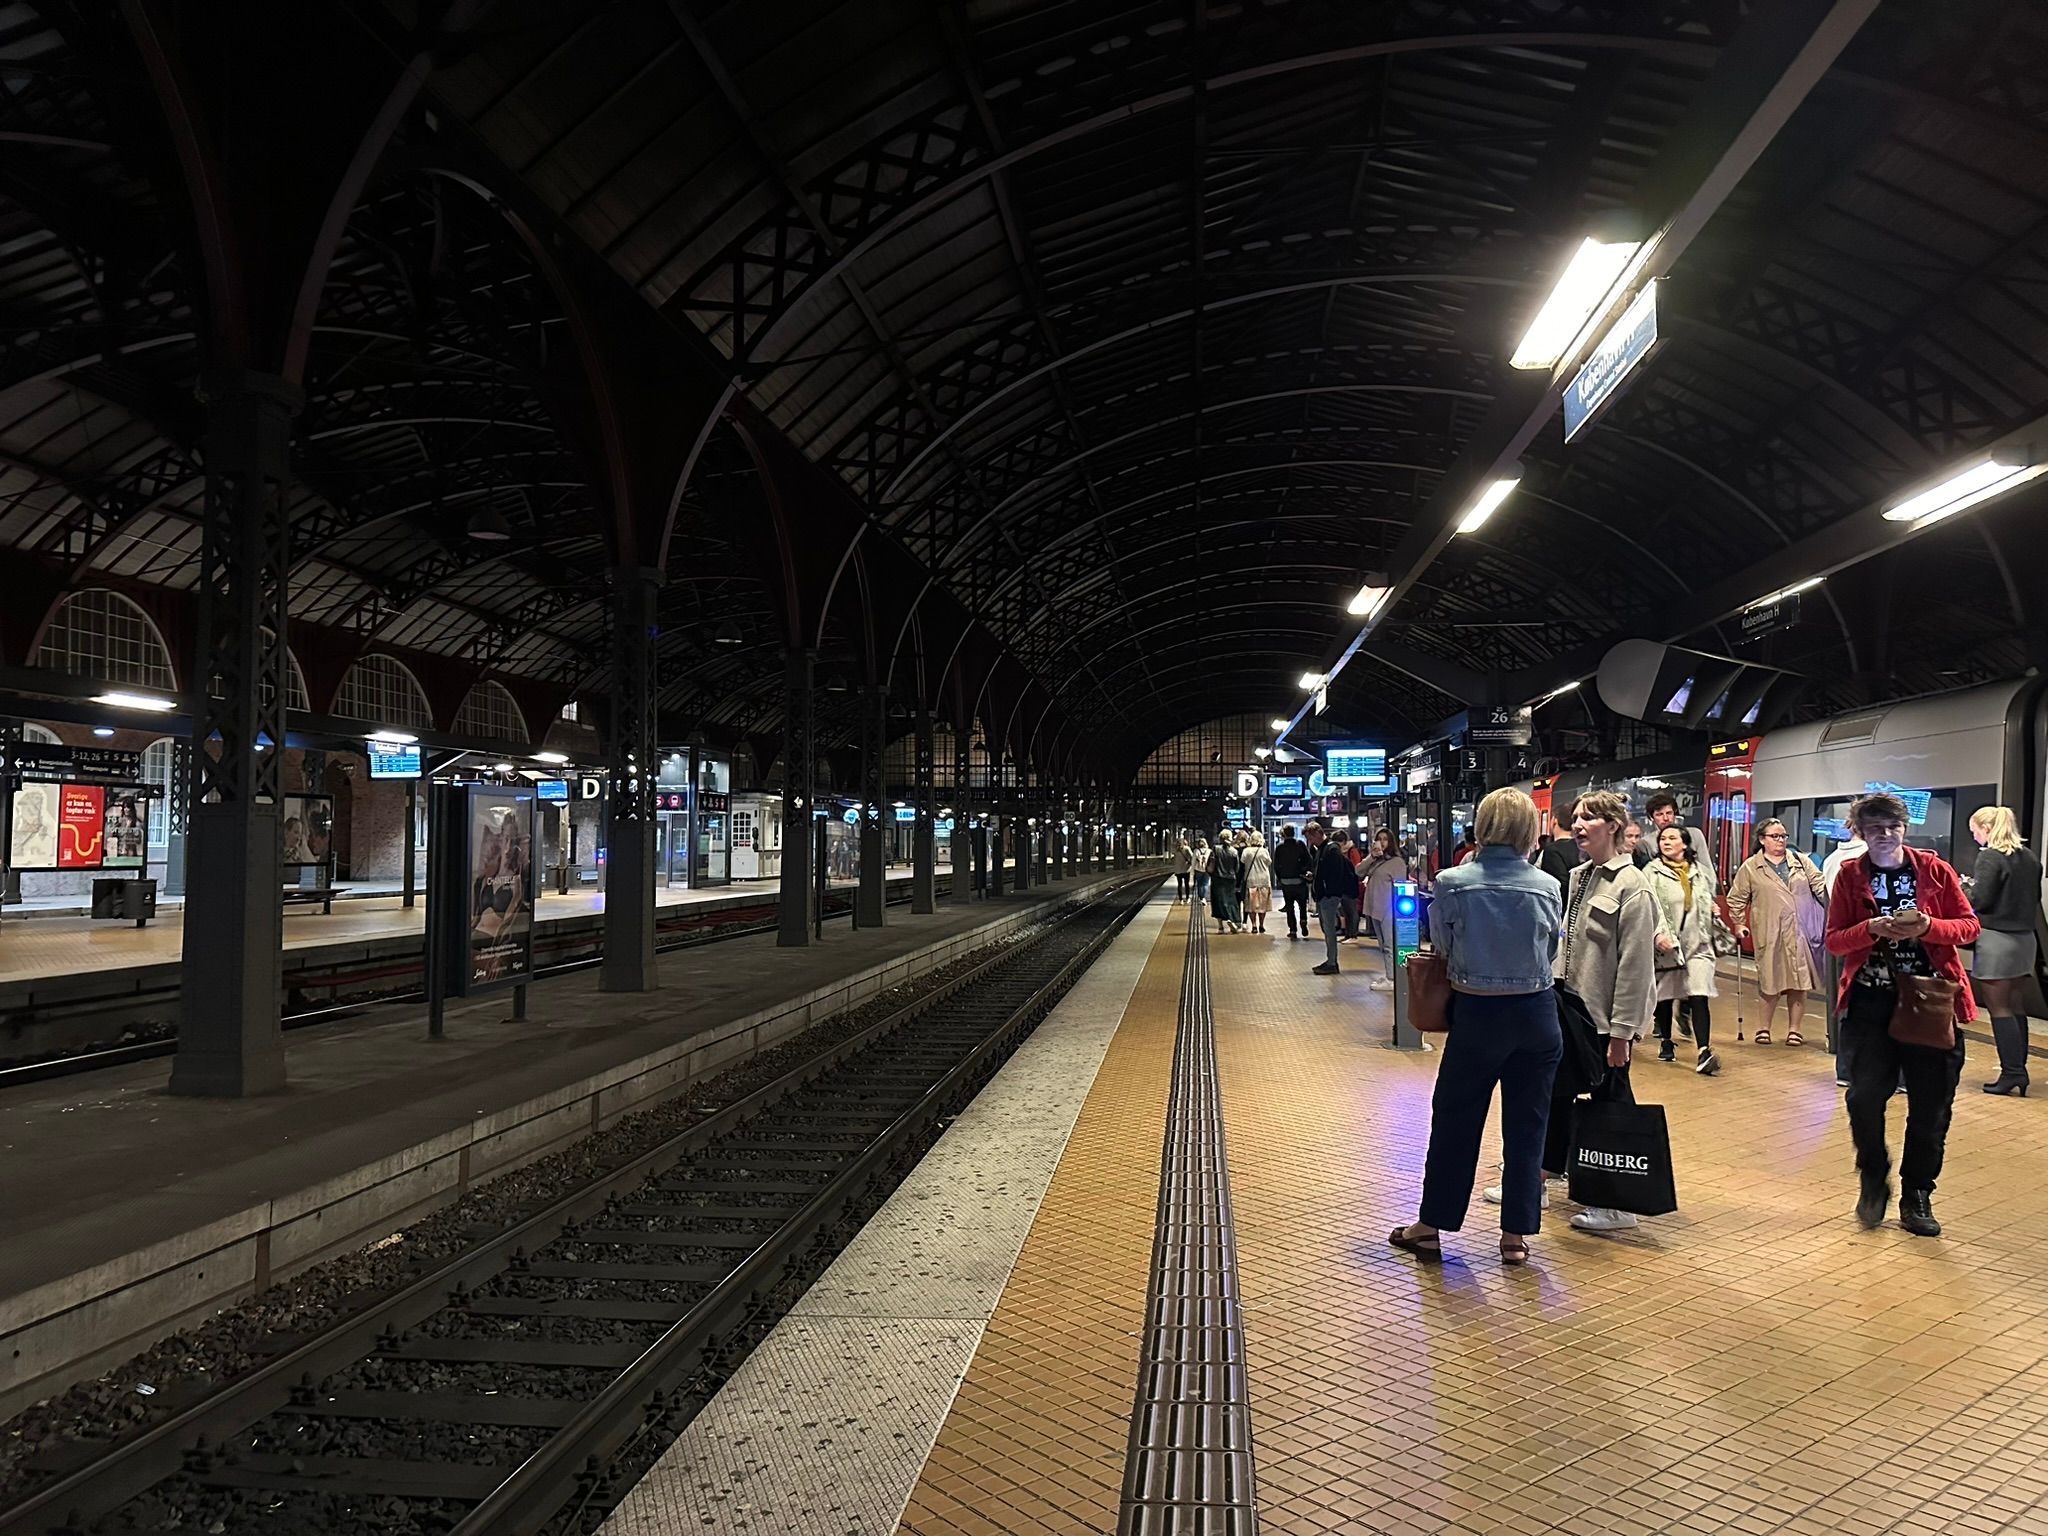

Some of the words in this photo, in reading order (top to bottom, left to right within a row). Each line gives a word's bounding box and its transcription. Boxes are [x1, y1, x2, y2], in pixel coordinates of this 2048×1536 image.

[1490, 711, 1509, 724] 26
[1468, 757, 1477, 769] 3
[1517, 757, 1527, 768] 4
[582, 778, 599, 800] D
[1237, 773, 1259, 797] D
[66, 792, 89, 802] Sverige
[1577, 1147, 1649, 1170] HØIBERG
